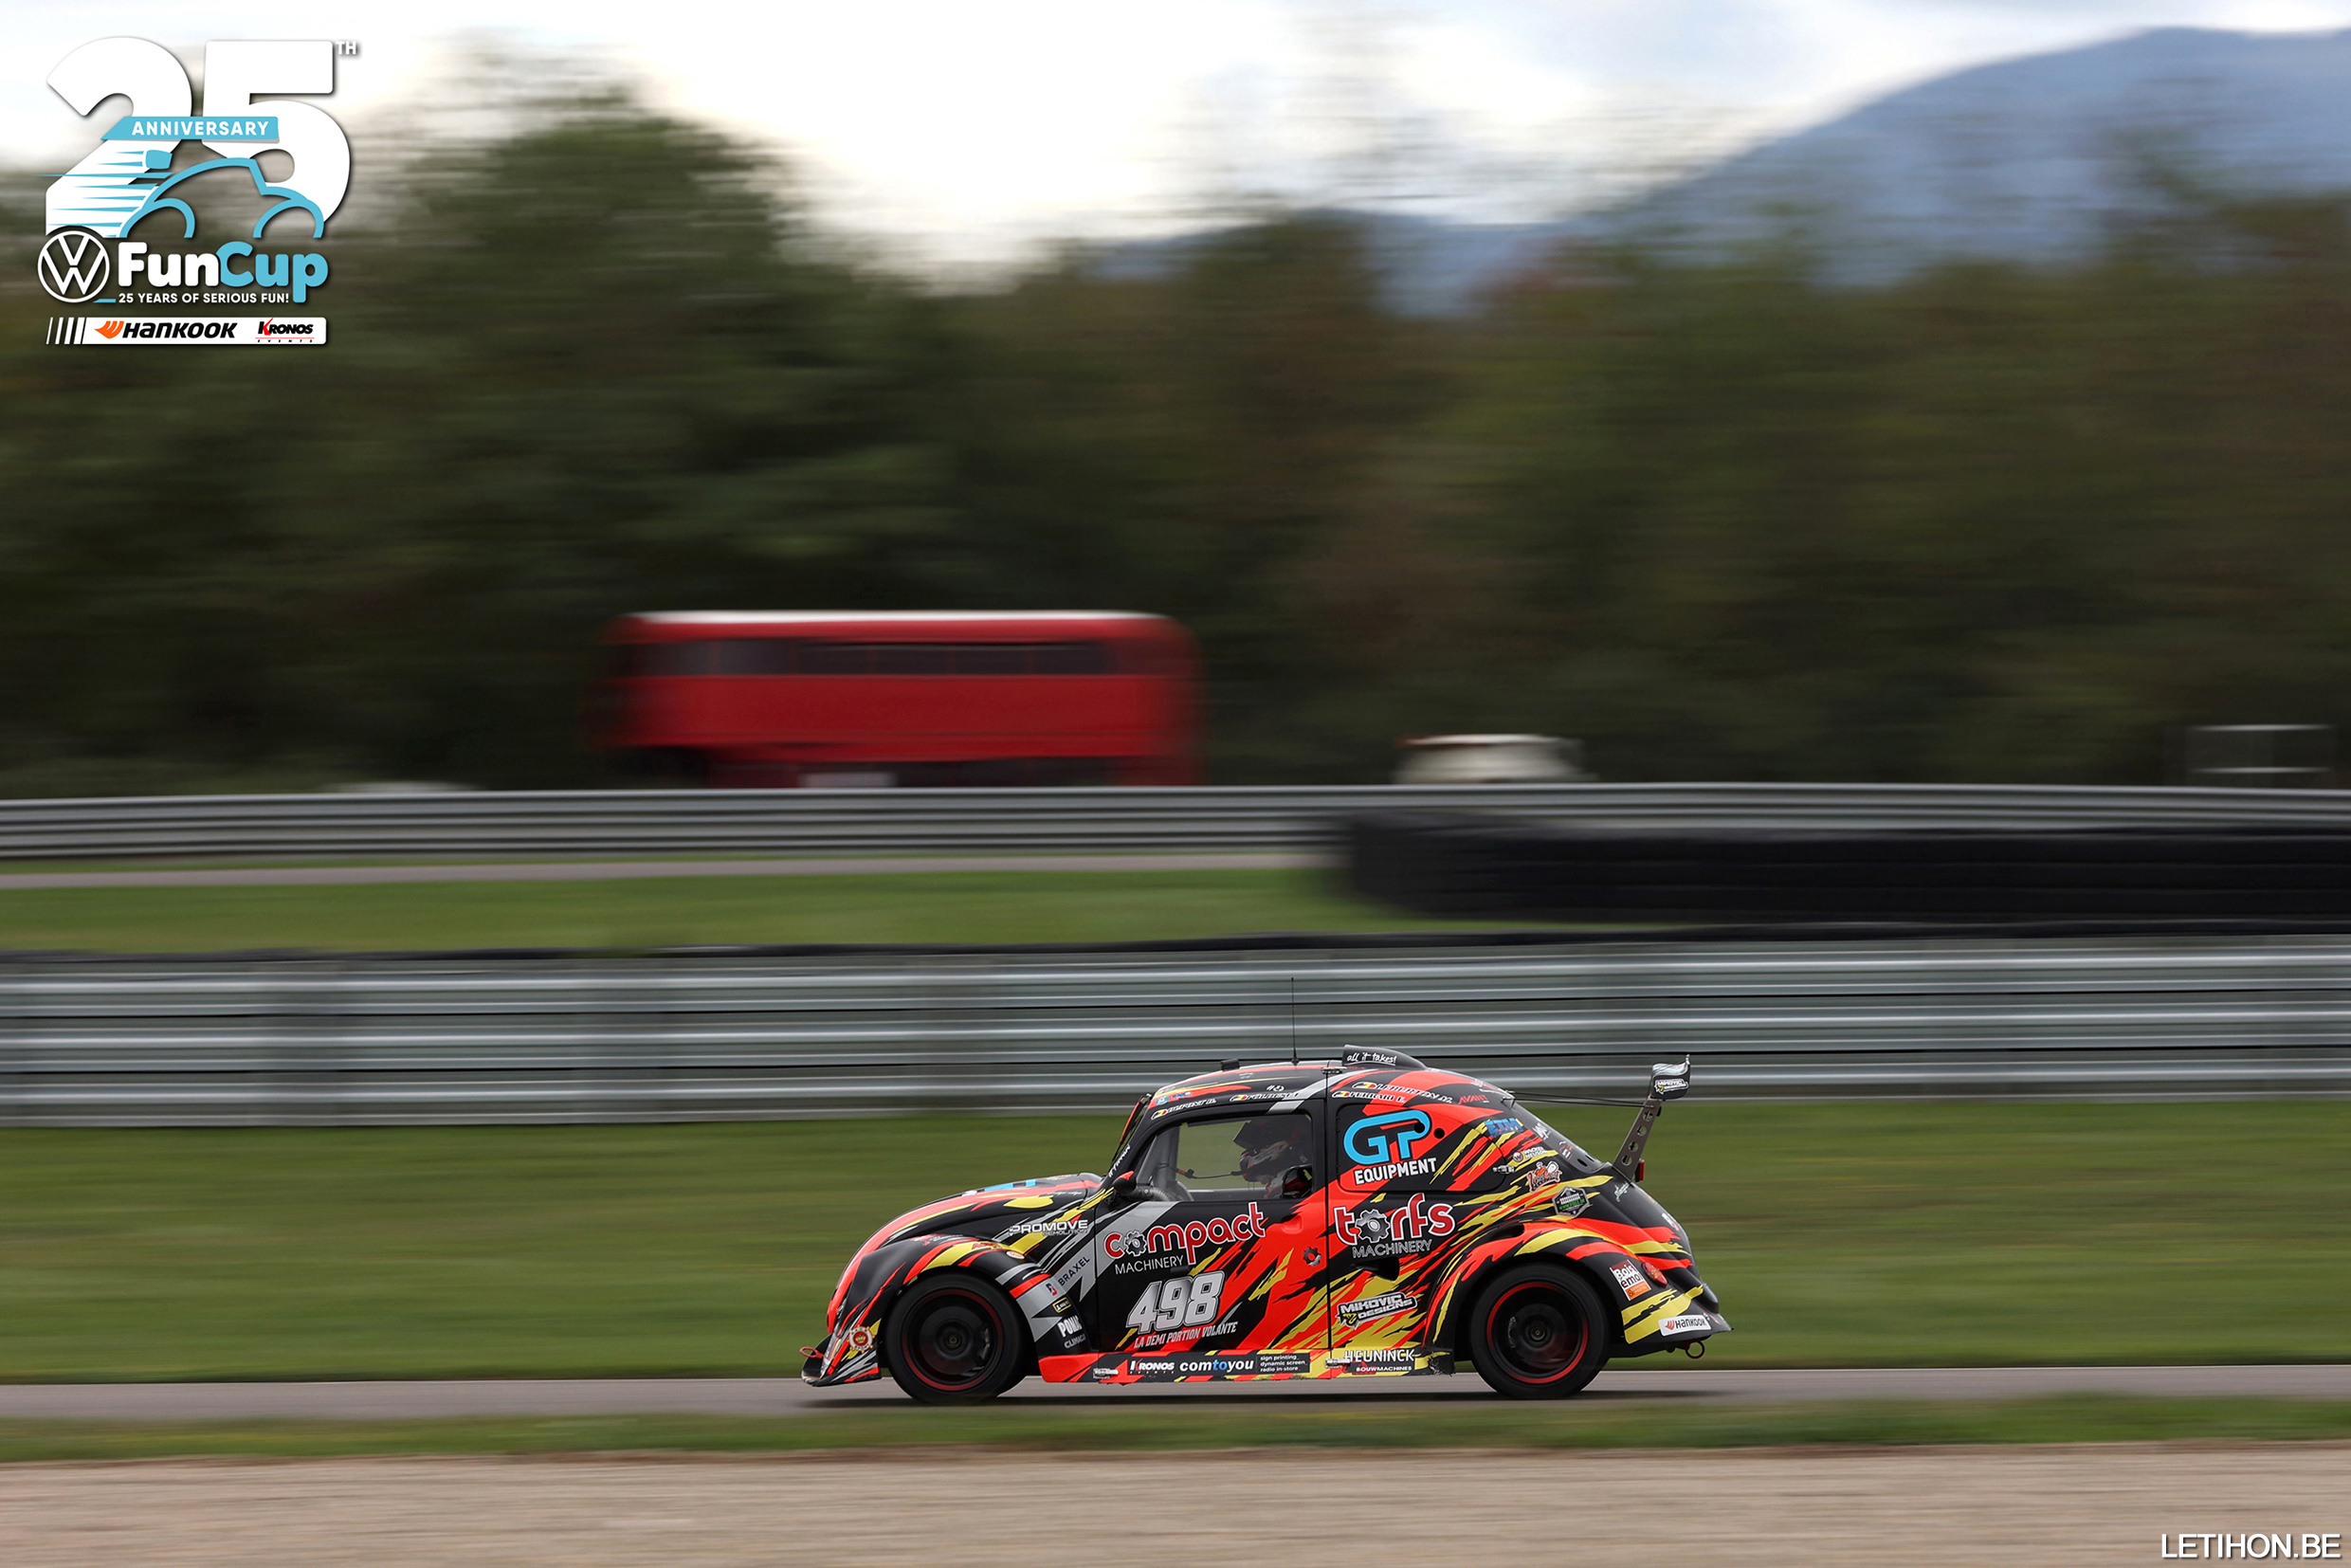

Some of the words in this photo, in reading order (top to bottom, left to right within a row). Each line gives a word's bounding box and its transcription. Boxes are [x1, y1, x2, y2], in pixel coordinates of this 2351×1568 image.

[1346, 1051, 1359, 1063] all
[1372, 1051, 1397, 1065] takes!
[1343, 1109, 1432, 1165] GP
[1354, 1157, 1437, 1185] EQUIPMENT
[1011, 1220, 1088, 1234] PROMOVE
[1352, 1238, 1432, 1259] MACHINERY
[1057, 1256, 1091, 1286] BRAXEL
[1115, 1254, 1185, 1275] MACHINERY
[1125, 1270, 1226, 1335] 498
[1340, 1294, 1403, 1314] MIKOVIC
[1133, 1338, 1144, 1349] LA
[1145, 1334, 1166, 1346] DEMI
[1166, 1327, 1201, 1343] PORTION
[1201, 1321, 1238, 1338] VOLANTE
[1343, 1348, 1415, 1363] HEUNINCK
[1179, 1358, 1254, 1375] comtoyou
